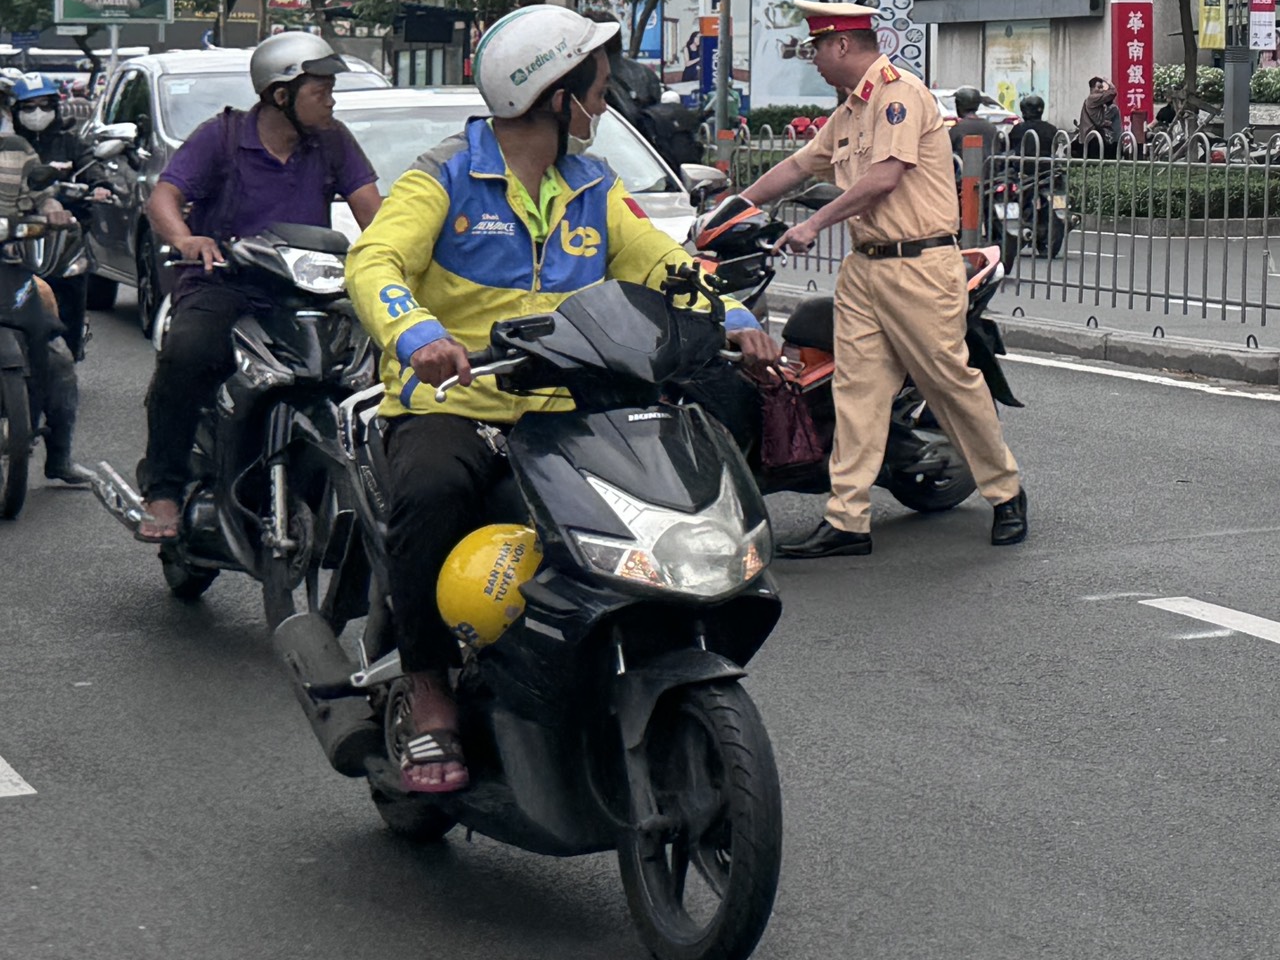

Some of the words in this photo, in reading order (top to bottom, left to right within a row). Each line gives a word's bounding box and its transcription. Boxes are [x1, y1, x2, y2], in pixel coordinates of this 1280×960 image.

[1127, 10, 1146, 110] 華南銀行
[472, 221, 515, 231] ADVANCE
[561, 219, 601, 257] be
